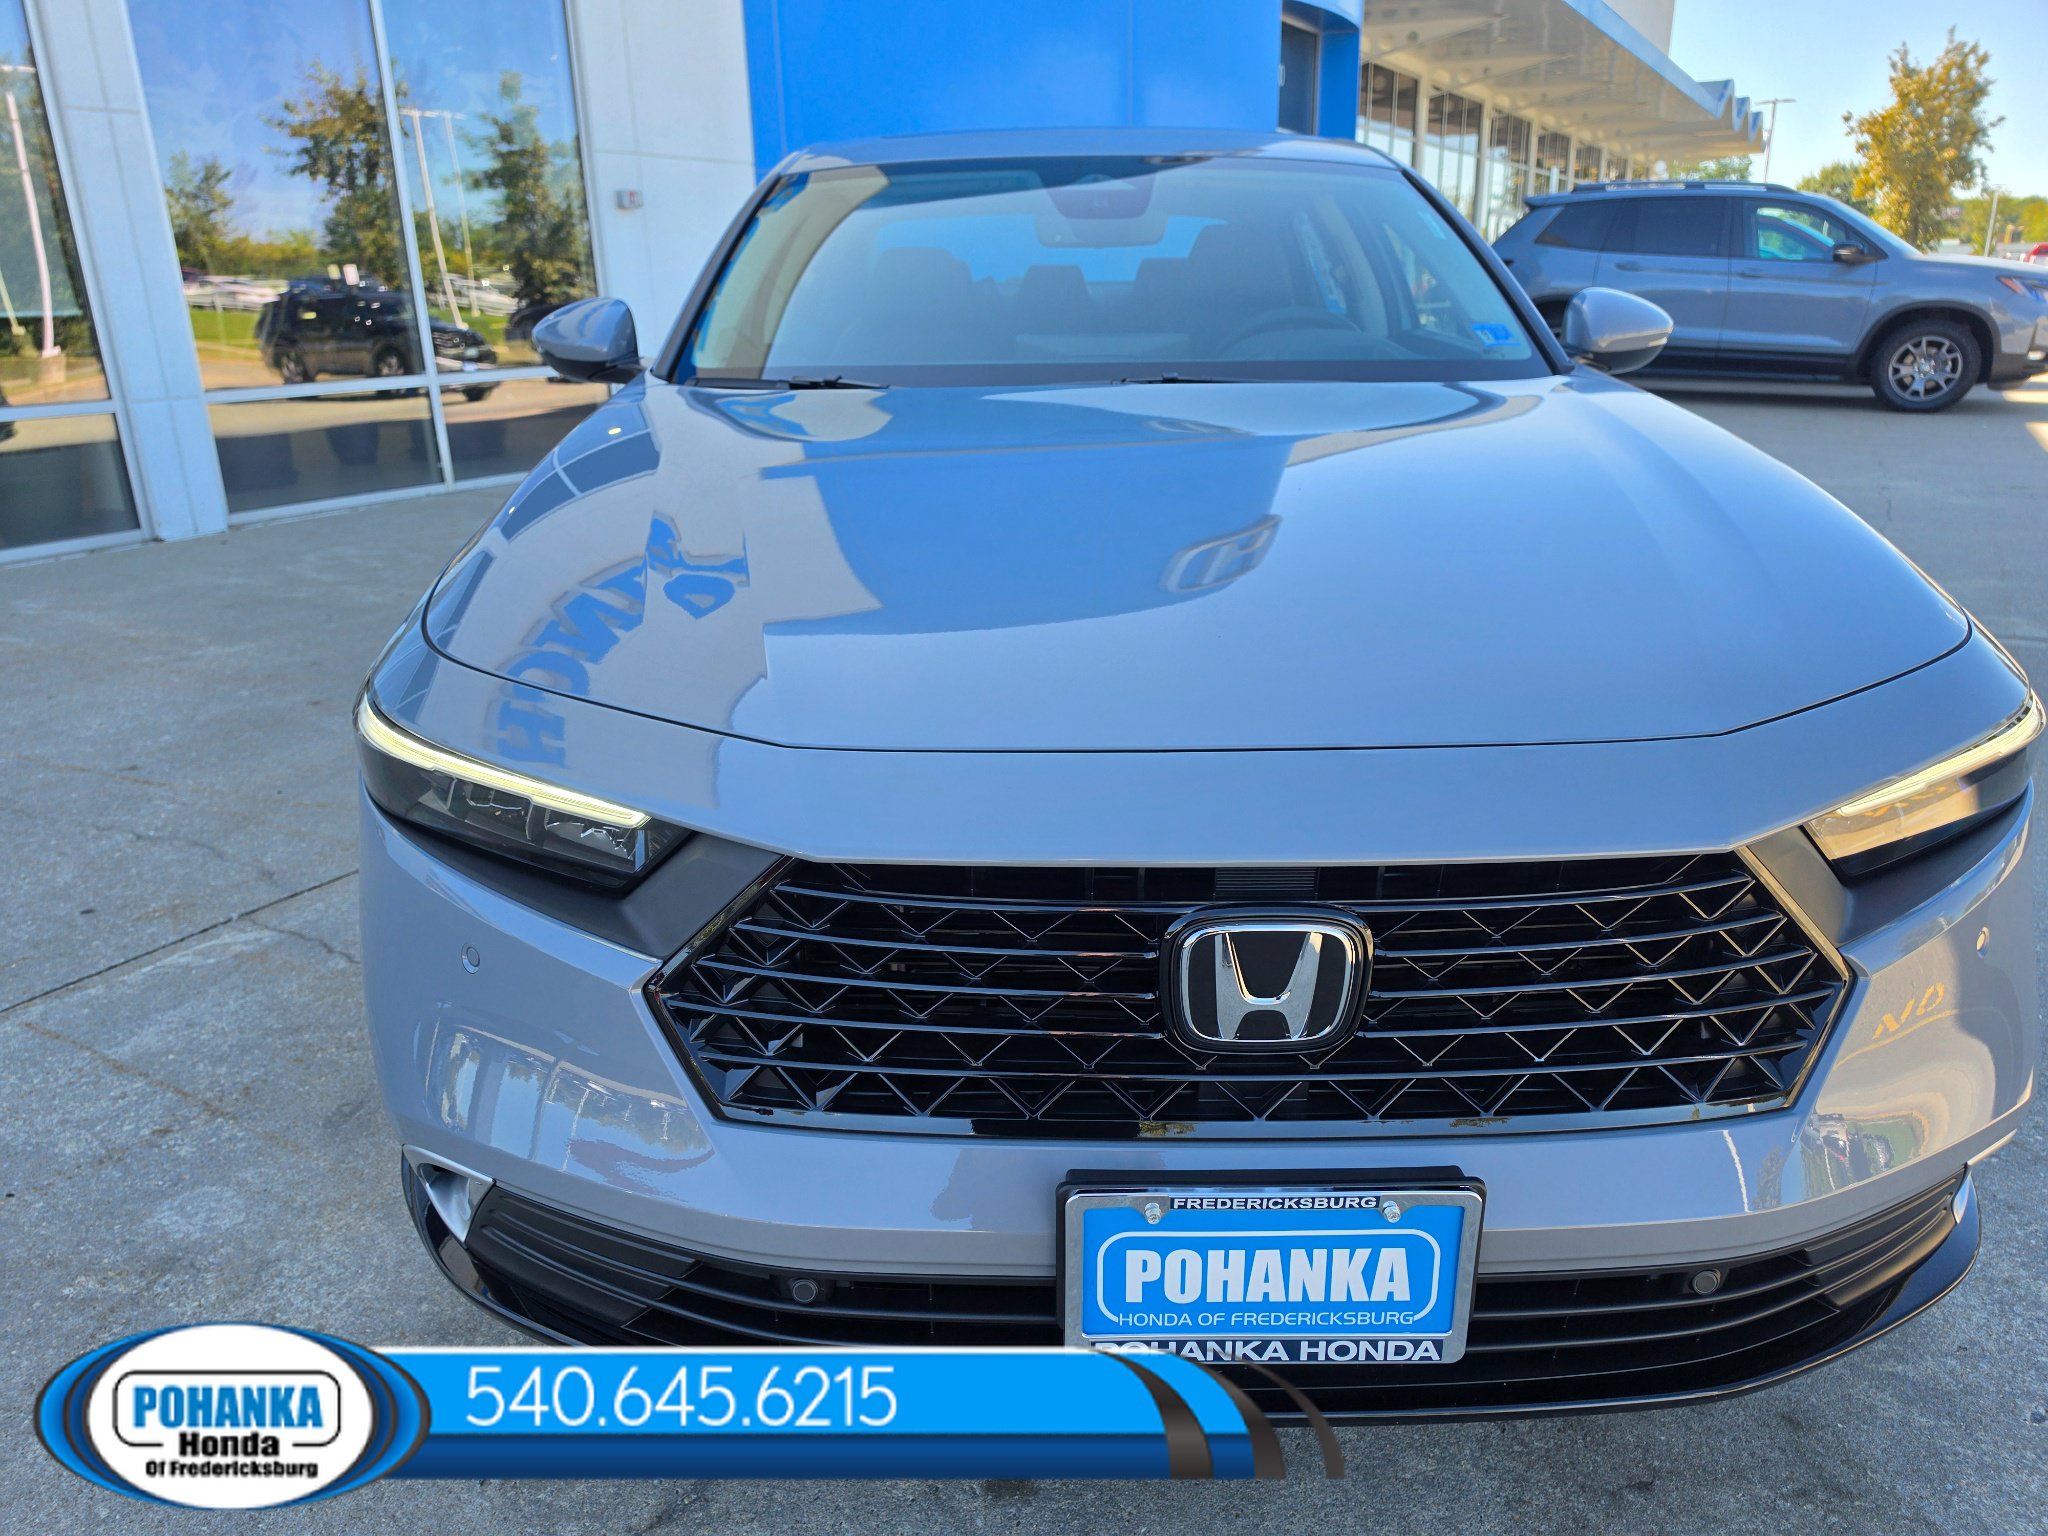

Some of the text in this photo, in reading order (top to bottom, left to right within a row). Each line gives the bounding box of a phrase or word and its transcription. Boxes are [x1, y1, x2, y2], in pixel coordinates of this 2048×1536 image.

[1173, 1196, 1377, 1210] FREDERICKSBURG
[1125, 1247, 1411, 1304] POHANKA
[1119, 1311, 1415, 1327] HONDA OF FREDERICKSBURG
[1300, 1340, 1441, 1361] HONDA
